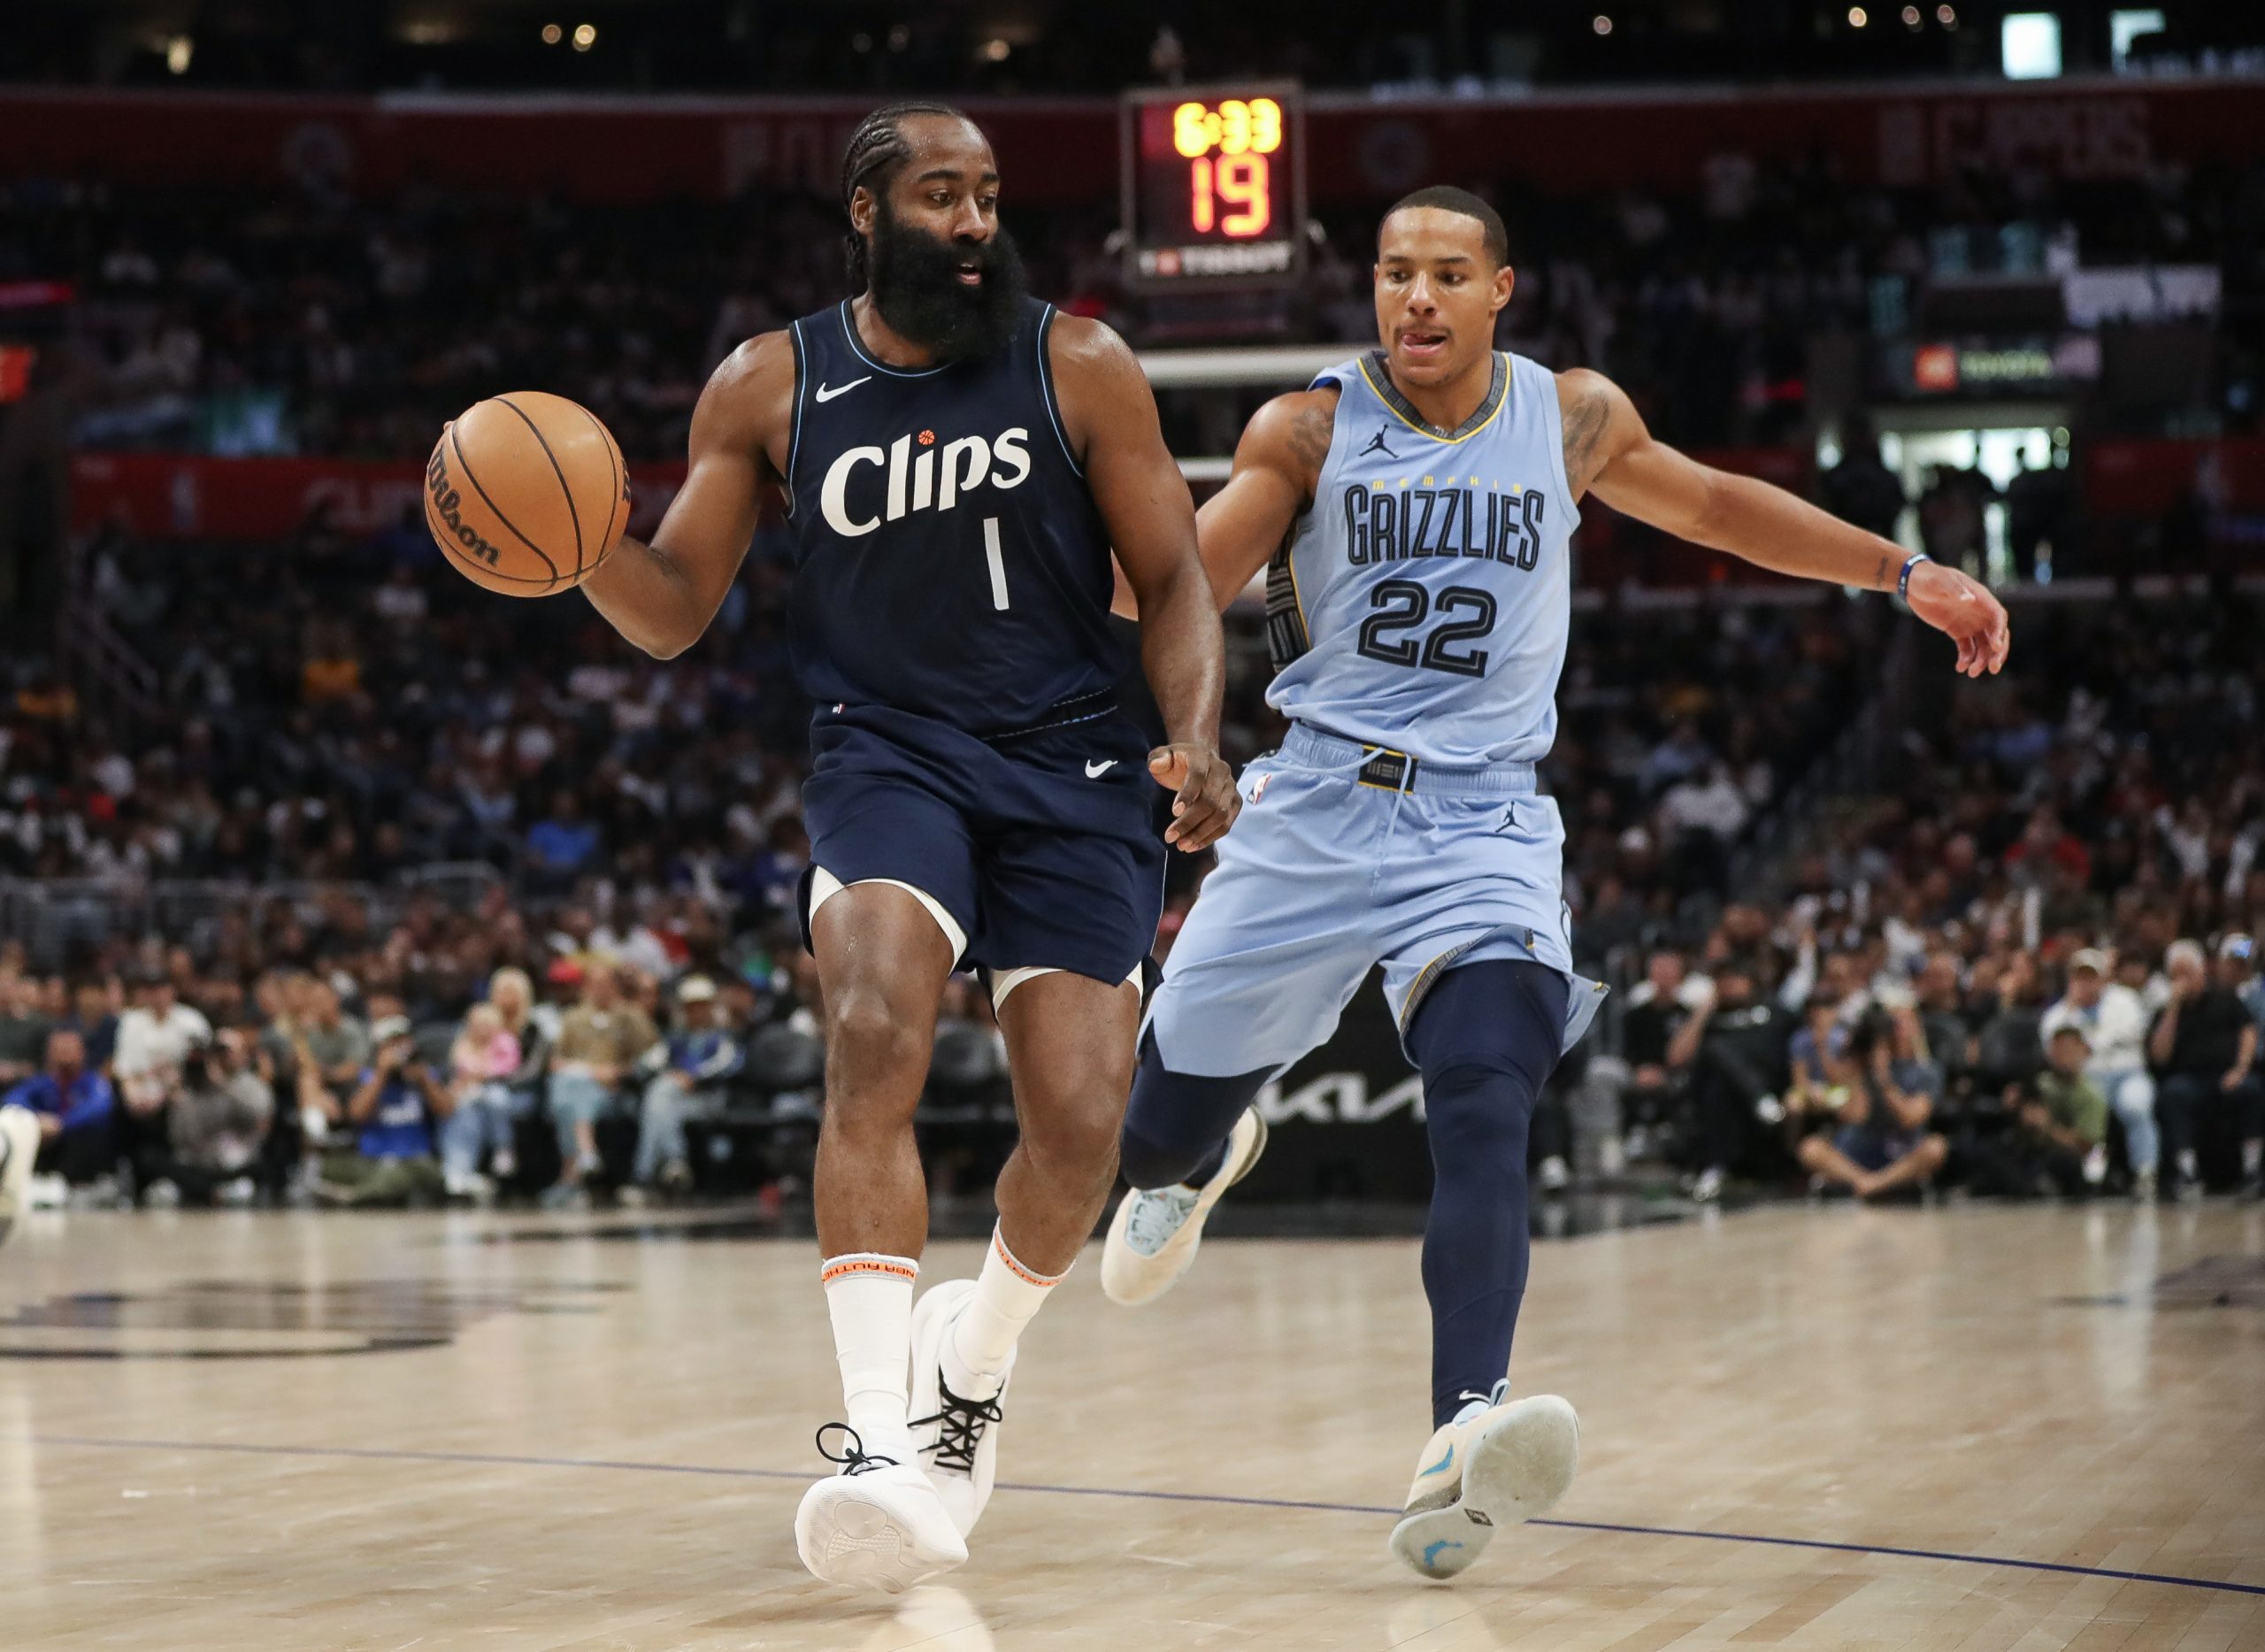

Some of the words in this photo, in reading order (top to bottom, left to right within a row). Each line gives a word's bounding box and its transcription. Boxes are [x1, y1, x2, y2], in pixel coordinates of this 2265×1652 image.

[1174, 98, 1282, 158] 6:33
[1192, 151, 1270, 237] 19
[428, 443, 500, 567] Wilson
[820, 426, 1032, 537] Clips
[983, 517, 1010, 611] 1
[1344, 484, 1545, 572] GRIZZLIES
[1356, 580, 1497, 679] 22
[821, 1263, 880, 1283] AUTHE
[885, 1264, 915, 1279] NBA
